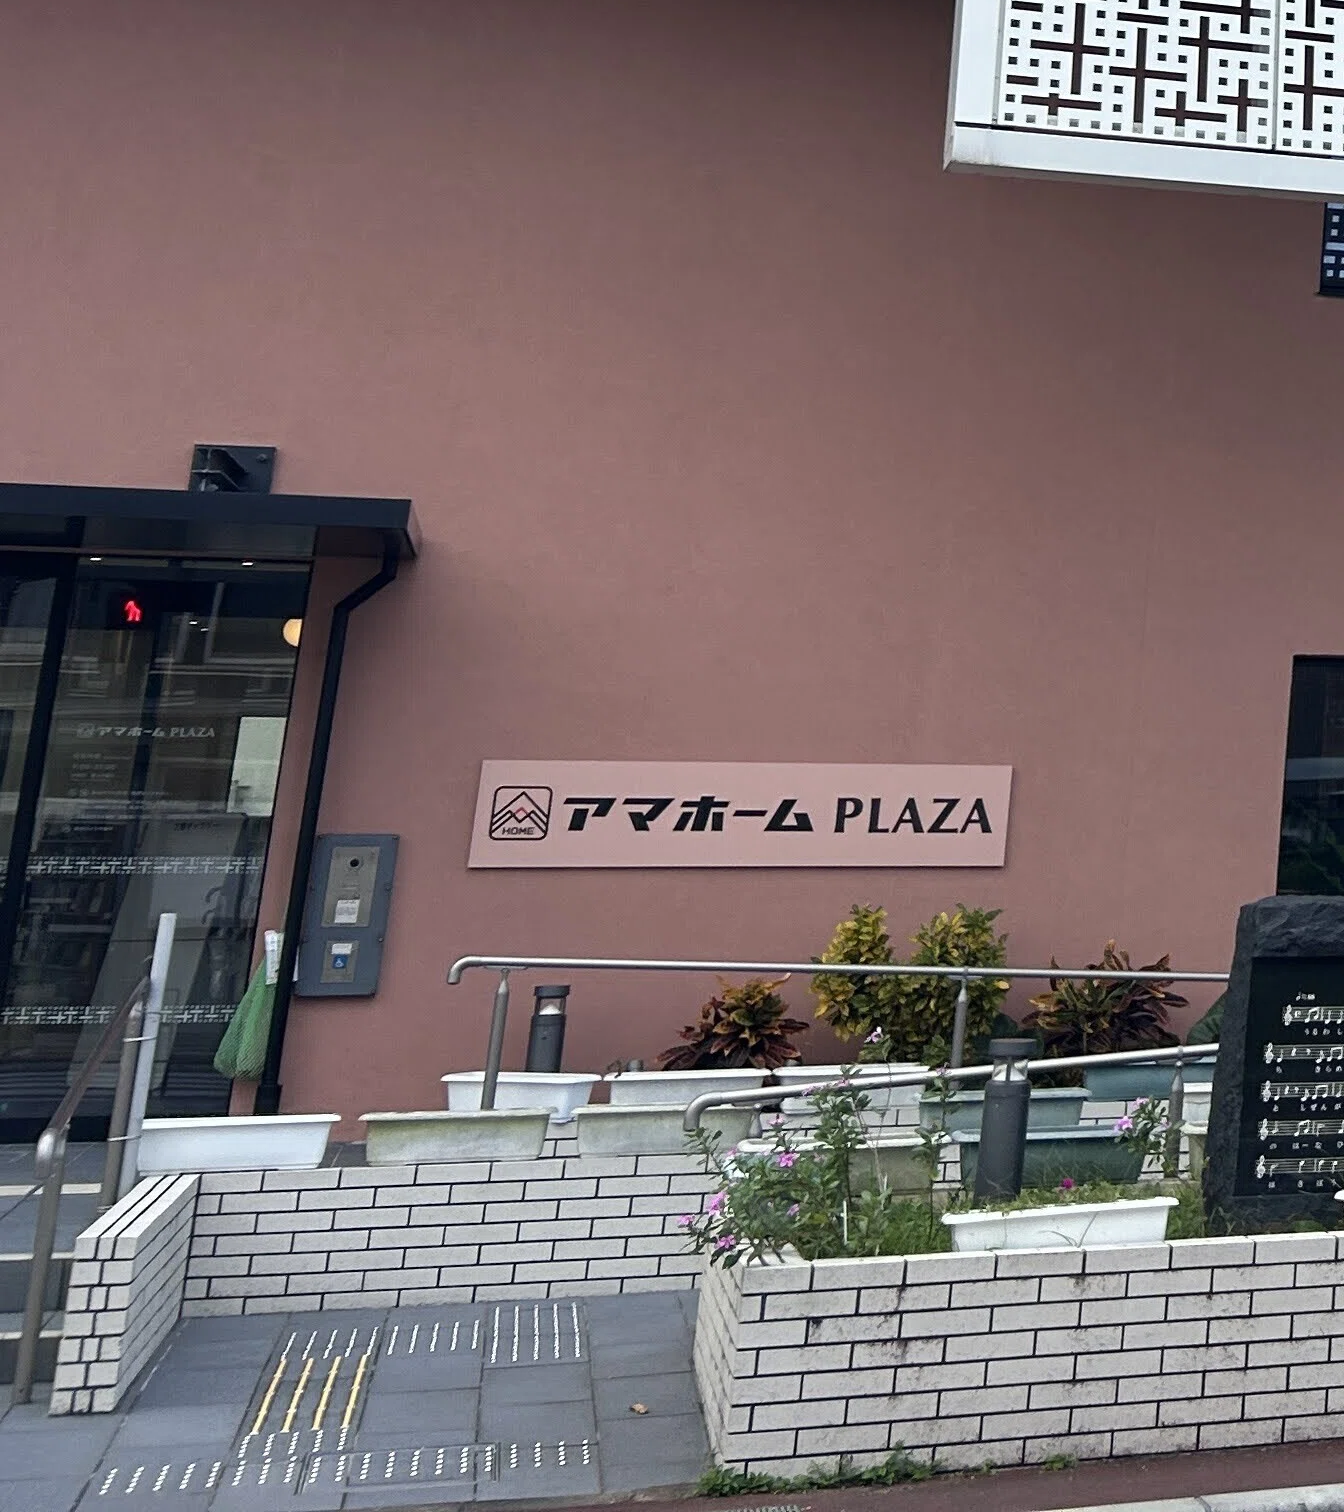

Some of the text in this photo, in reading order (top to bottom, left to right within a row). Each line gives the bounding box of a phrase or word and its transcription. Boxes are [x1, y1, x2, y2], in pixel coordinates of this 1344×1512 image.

[563, 796, 993, 834] アマホーム PLAZA
[501, 826, 535, 835] HOME
